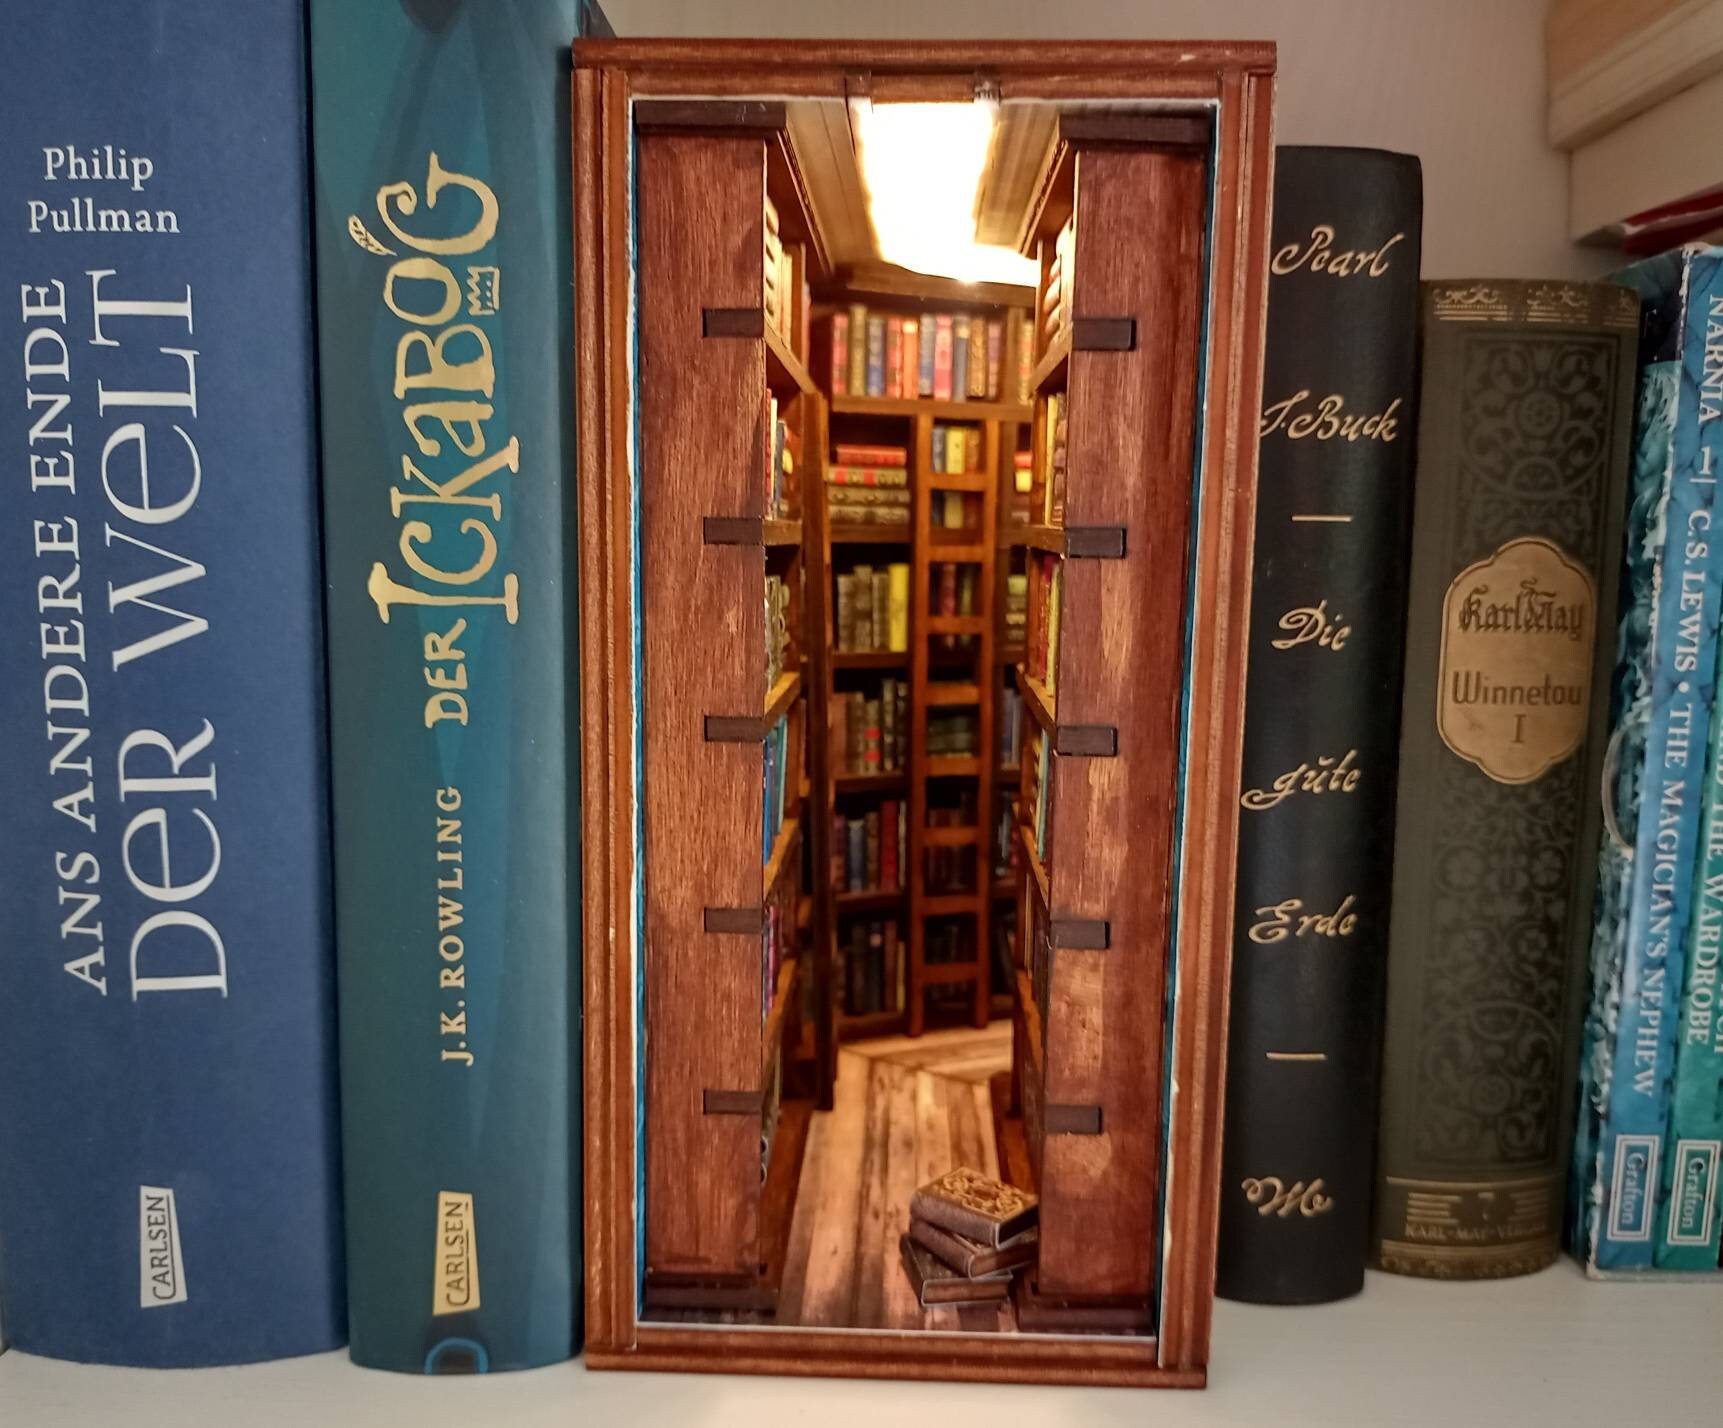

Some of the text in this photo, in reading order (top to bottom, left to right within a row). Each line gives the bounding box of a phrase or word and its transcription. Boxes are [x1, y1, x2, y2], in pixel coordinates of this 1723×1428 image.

[43, 145, 154, 192] Philip
[28, 199, 180, 234] Pullman
[1271, 224, 1405, 277] Pearl
[1698, 294, 1723, 424] NARNIA
[1288, 394, 1403, 442] Buck
[21, 278, 107, 996] ANS ANDERE ENDE
[1271, 600, 1352, 650] Die
[424, 618, 469, 729] DER
[1451, 671, 1582, 706] Winnetou
[1512, 714, 1527, 743] I
[1665, 703, 1692, 769] THE
[435, 786, 465, 988] ROWLING
[1646, 779, 1685, 958] MAGICIAN'S
[1249, 895, 1358, 944] Erde
[1687, 876, 1723, 1046] WARDROBE
[1633, 967, 1664, 1098] NEPHEW
[1622, 1152, 1645, 1224] Grafton
[1682, 1157, 1706, 1228] Grafton
[145, 1195, 176, 1300] CARLSEN
[445, 1201, 470, 1307] CARLSEN
